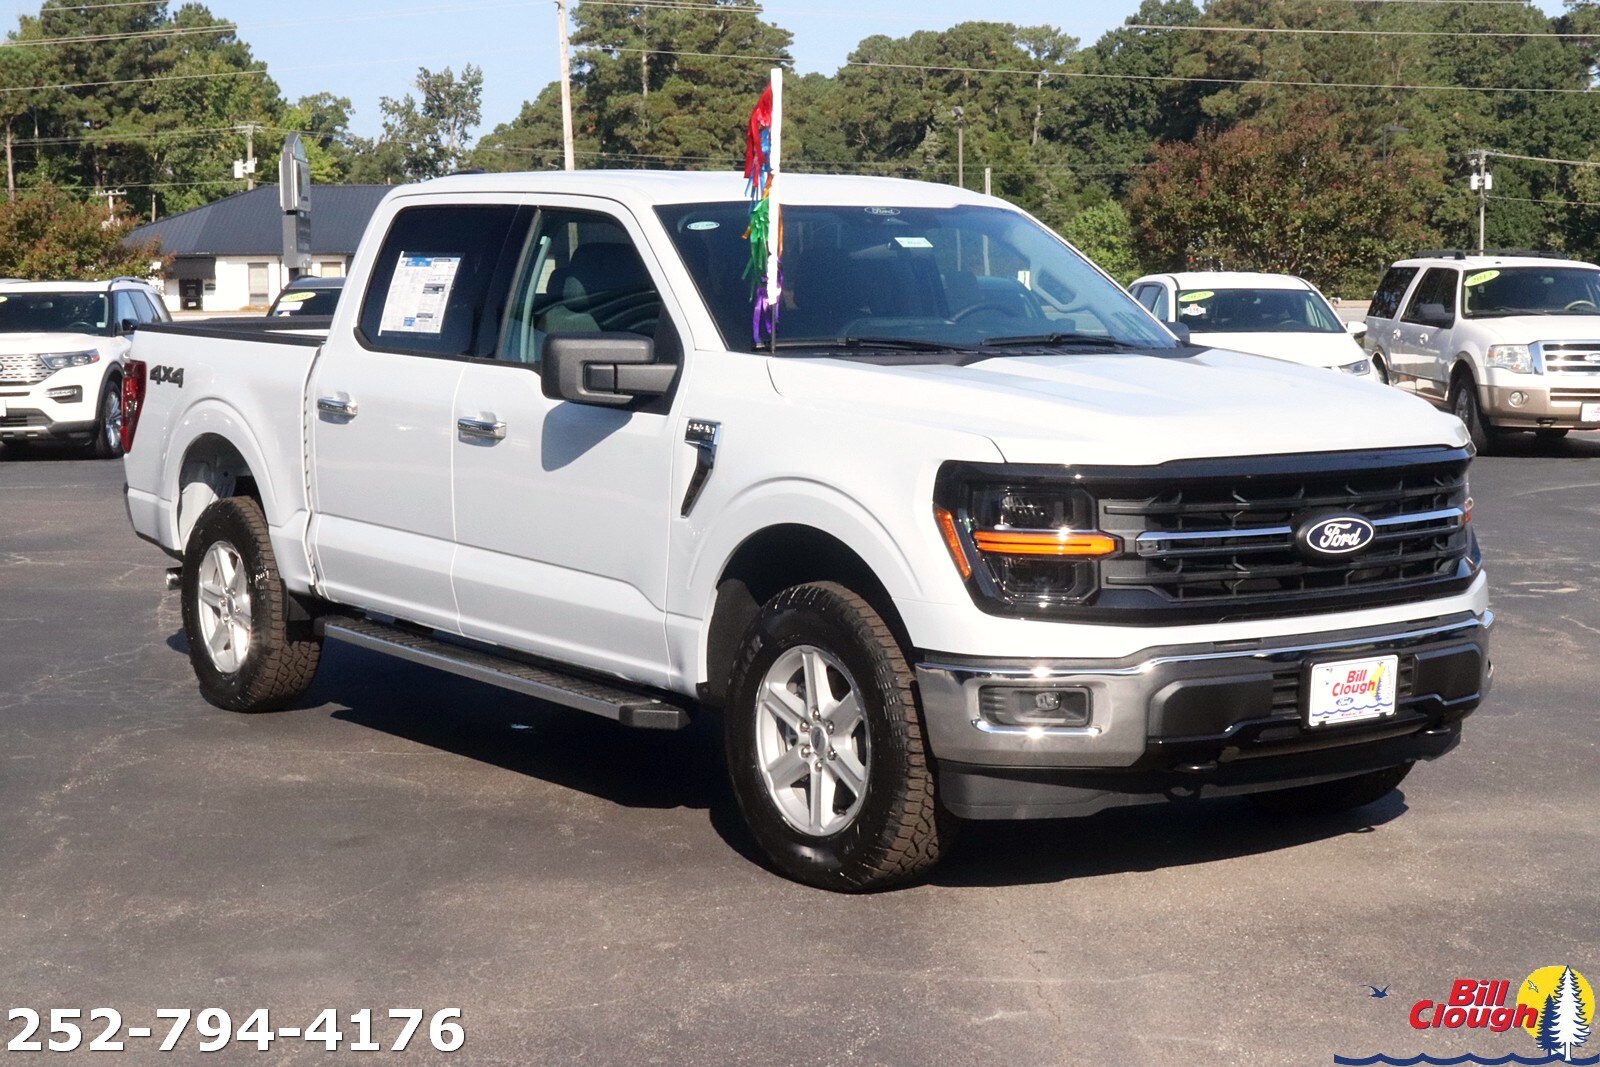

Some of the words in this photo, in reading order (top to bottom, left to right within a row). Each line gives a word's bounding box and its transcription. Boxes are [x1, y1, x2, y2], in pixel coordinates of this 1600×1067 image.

[1320, 523, 1361, 547] Ford
[1346, 669, 1367, 684] Bill
[1332, 680, 1376, 697] Clough
